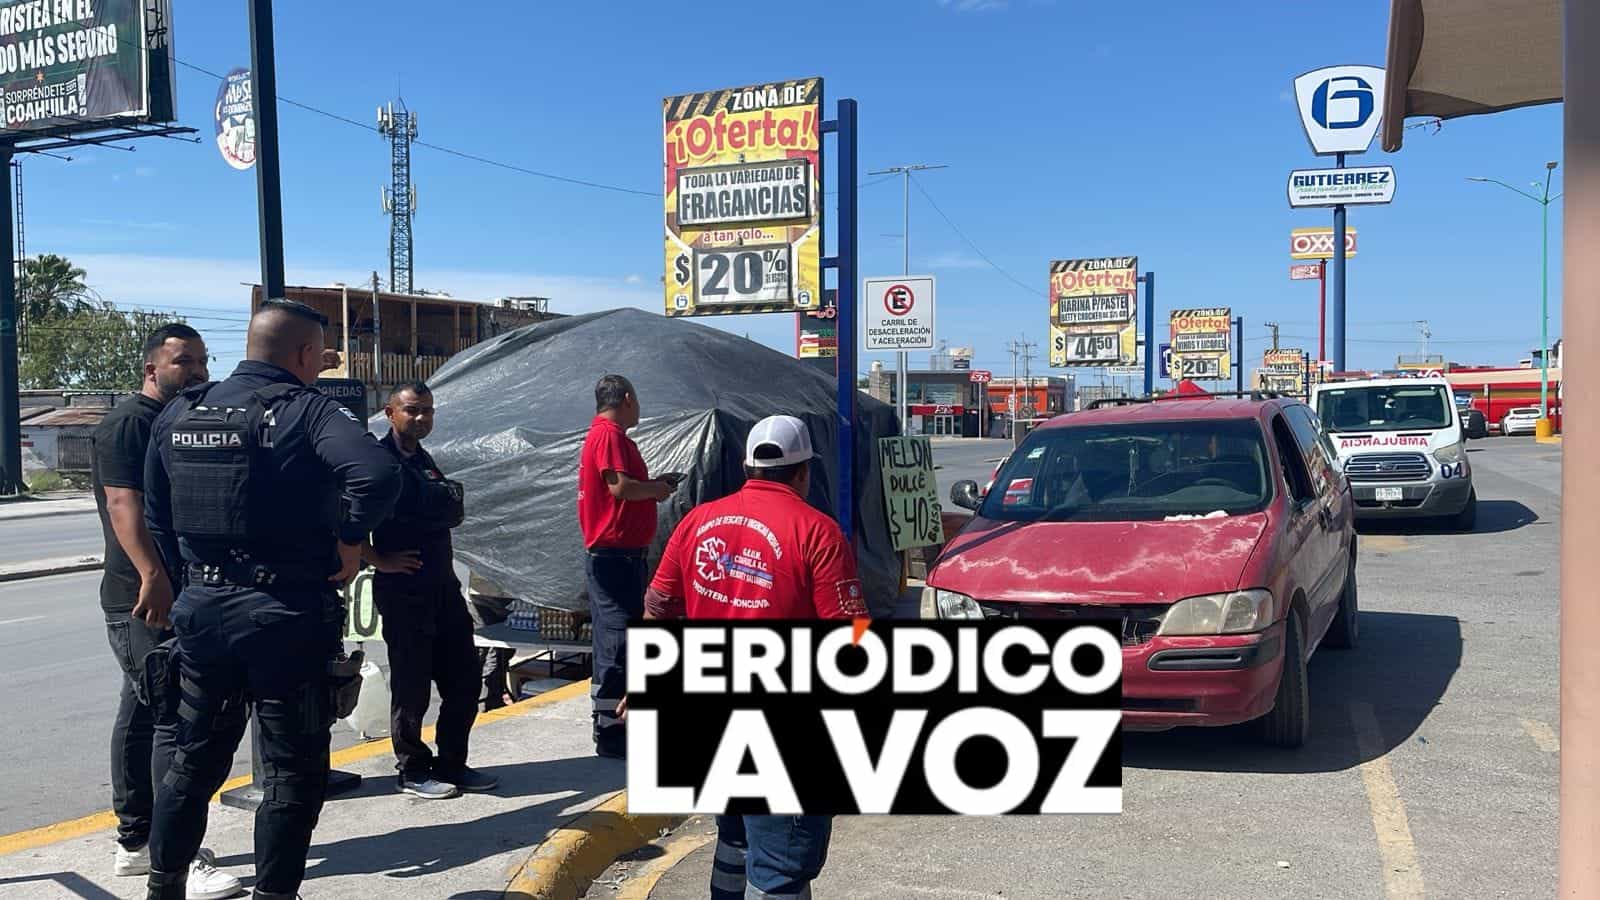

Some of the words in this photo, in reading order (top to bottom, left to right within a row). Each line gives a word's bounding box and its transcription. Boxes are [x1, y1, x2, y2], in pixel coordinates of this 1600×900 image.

[53, 0, 74, 25] EN
[76, 0, 94, 20] EL
[19, 29, 55, 71] MÁS
[57, 24, 118, 63] SEGURO
[6, 83, 65, 104] SORPRÉNDETE
[732, 88, 780, 111] ZONA
[784, 85, 806, 104] DE
[675, 110, 812, 162] ¡Oferta!
[685, 174, 713, 189] TODA
[715, 172, 728, 186] LA
[730, 168, 783, 185] VARIEDAD
[785, 166, 801, 181] DE
[1293, 171, 1390, 187] GUTIERREZ
[681, 183, 807, 221] FRAGANCIAS
[703, 232, 711, 243] a
[714, 230, 734, 242] tan
[675, 254, 690, 286] $
[1087, 259, 1113, 270] ZONA
[1115, 258, 1129, 269] DE
[868, 325, 931, 336] DESACELERACIÓN
[881, 318, 906, 327] CARRIL
[907, 318, 918, 326] DE
[872, 337, 877, 345] Y
[878, 335, 927, 345] ACELERACIÓN
[1055, 336, 1064, 351] $
[318, 385, 362, 398] ONEDAS
[172, 432, 242, 446] POLICIA
[880, 438, 933, 471] MELON
[1440, 462, 1467, 480] 04
[903, 496, 929, 542] 40
[343, 573, 379, 638] 0
